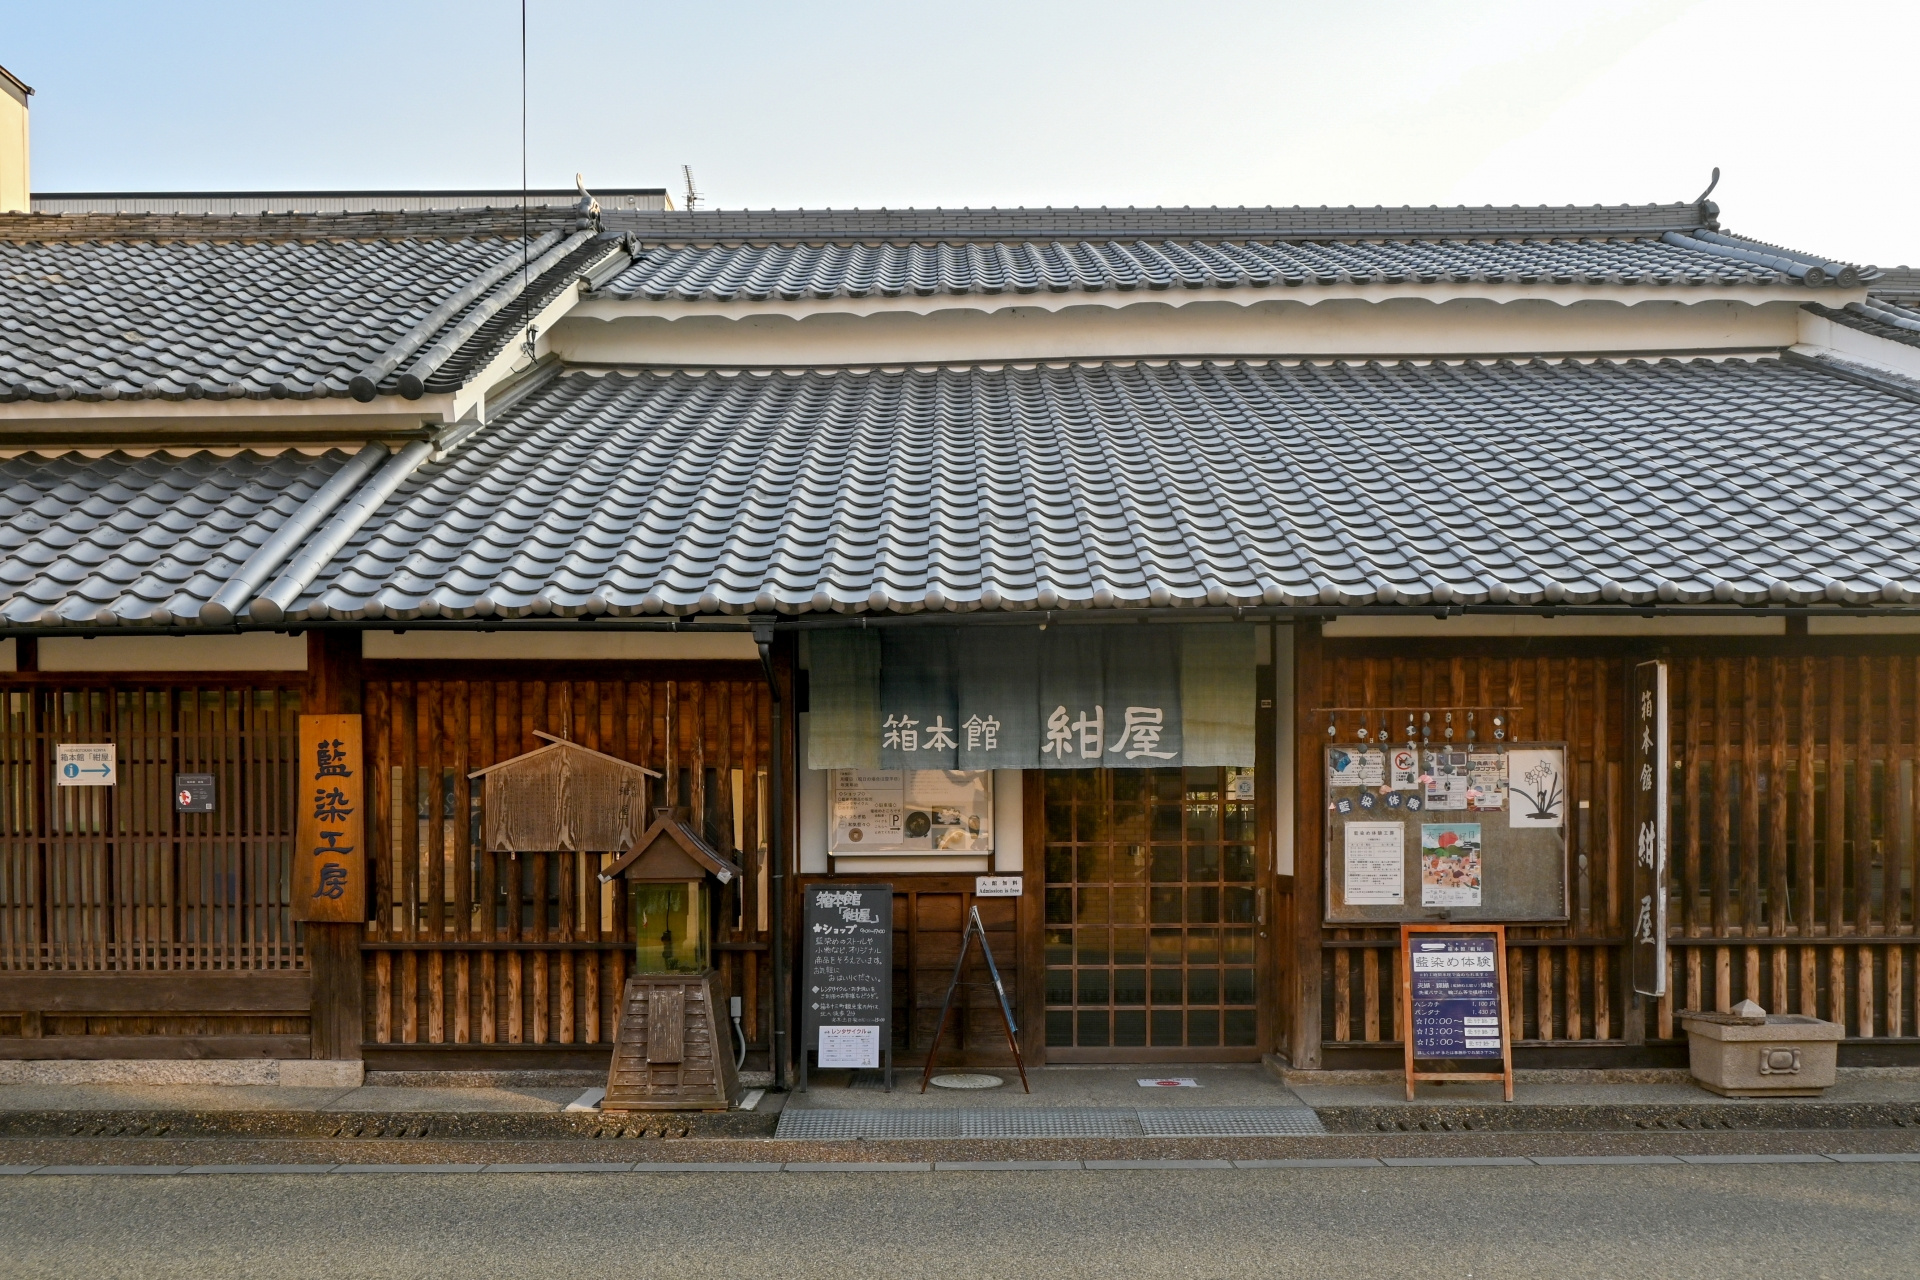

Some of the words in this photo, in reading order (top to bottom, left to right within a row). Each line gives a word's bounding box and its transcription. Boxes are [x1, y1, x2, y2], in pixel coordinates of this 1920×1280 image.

[882, 713, 1001, 752] 箱本館
[1041, 705, 1179, 760] 紺屋
[1640, 690, 1654, 792] 箱本館
[60, 753, 113, 762] 箱本館「紺屋」
[312, 738, 355, 900] 藍染工房
[892, 814, 900, 826] P
[1634, 820, 1656, 946] 紺屋
[815, 890, 862, 909] 箱本館
[822, 923, 858, 935] ショップ
[1415, 955, 1491, 967] 藍染め体験
